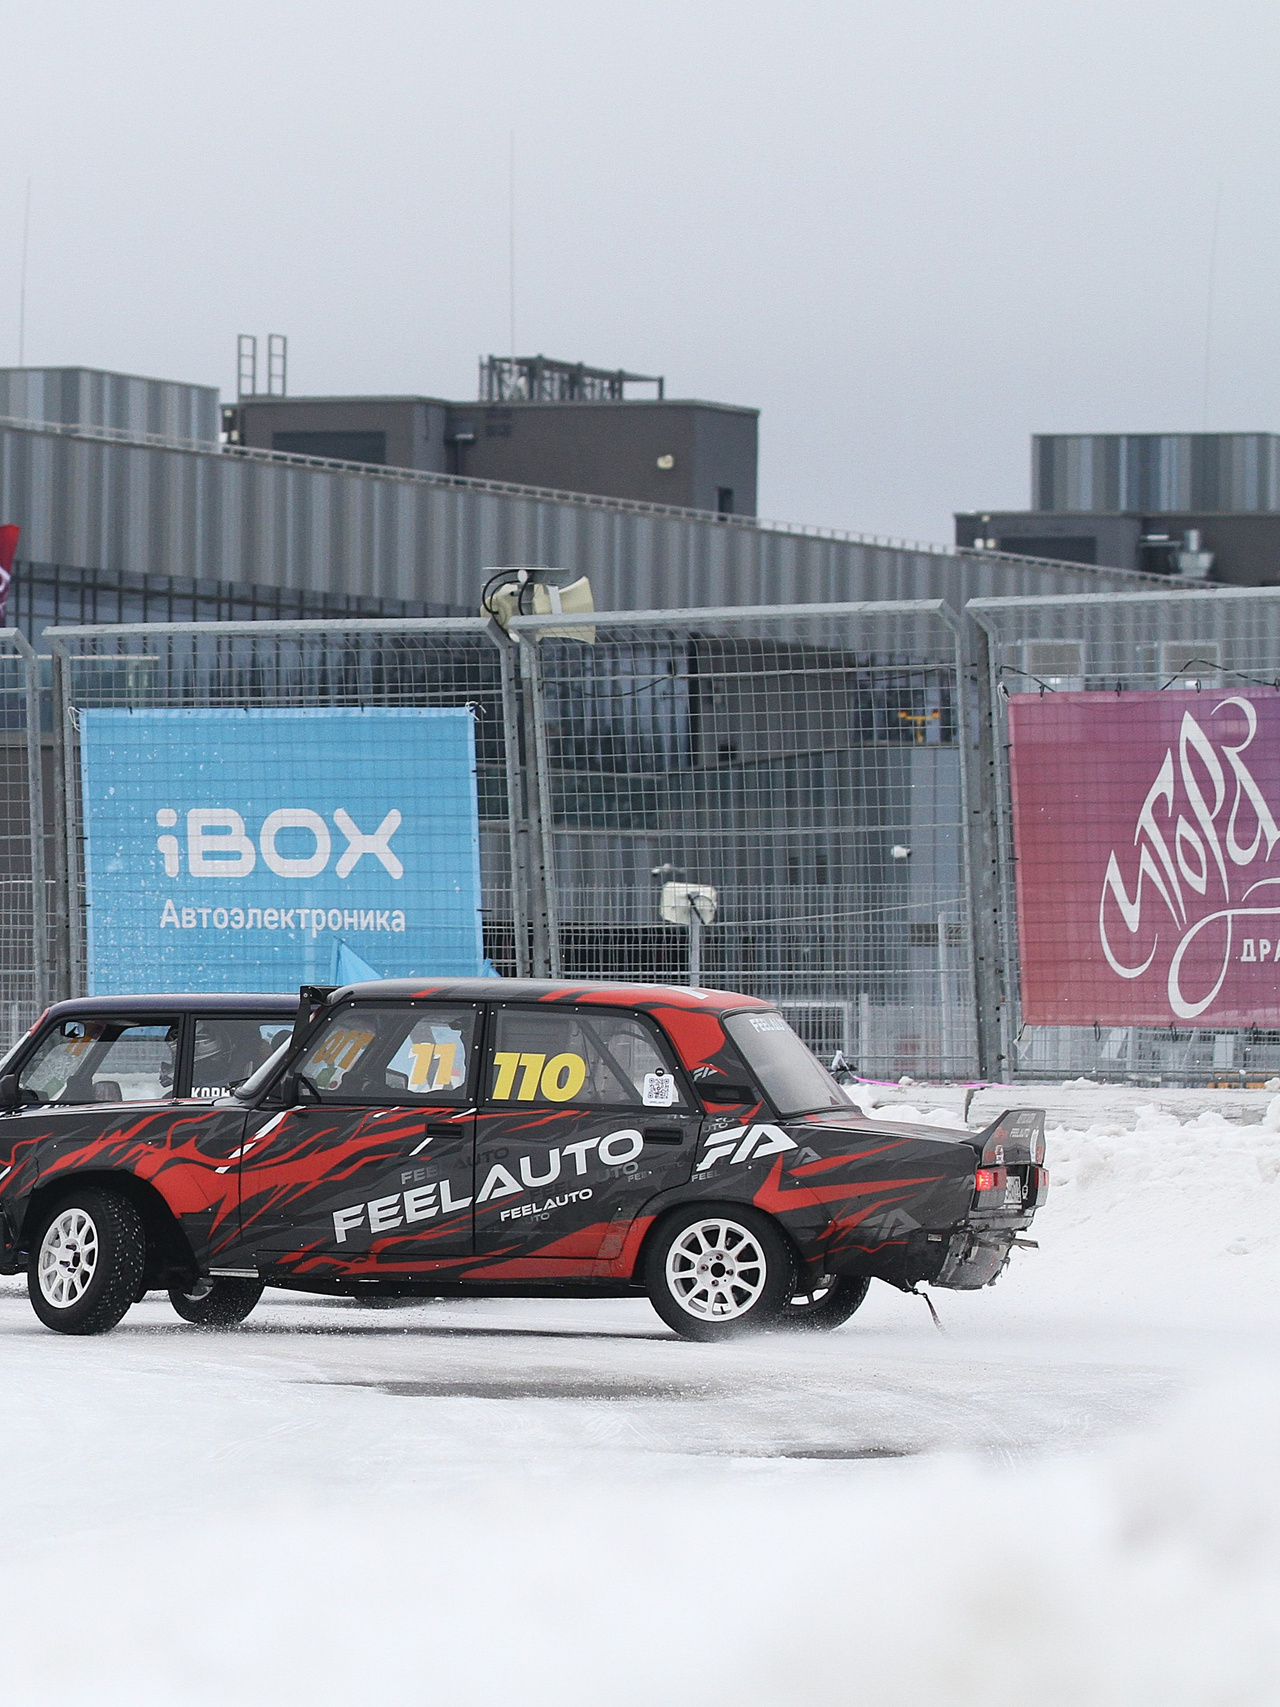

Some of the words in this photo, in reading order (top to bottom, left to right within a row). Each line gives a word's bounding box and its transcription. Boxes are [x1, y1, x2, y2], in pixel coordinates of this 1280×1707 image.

[156, 808, 404, 880] iBOX
[160, 899, 406, 939] Автоэлектроника
[492, 1052, 586, 1102] 110
[332, 1129, 644, 1244] FEELAUTO
[500, 1188, 593, 1222] FEELAUTO
